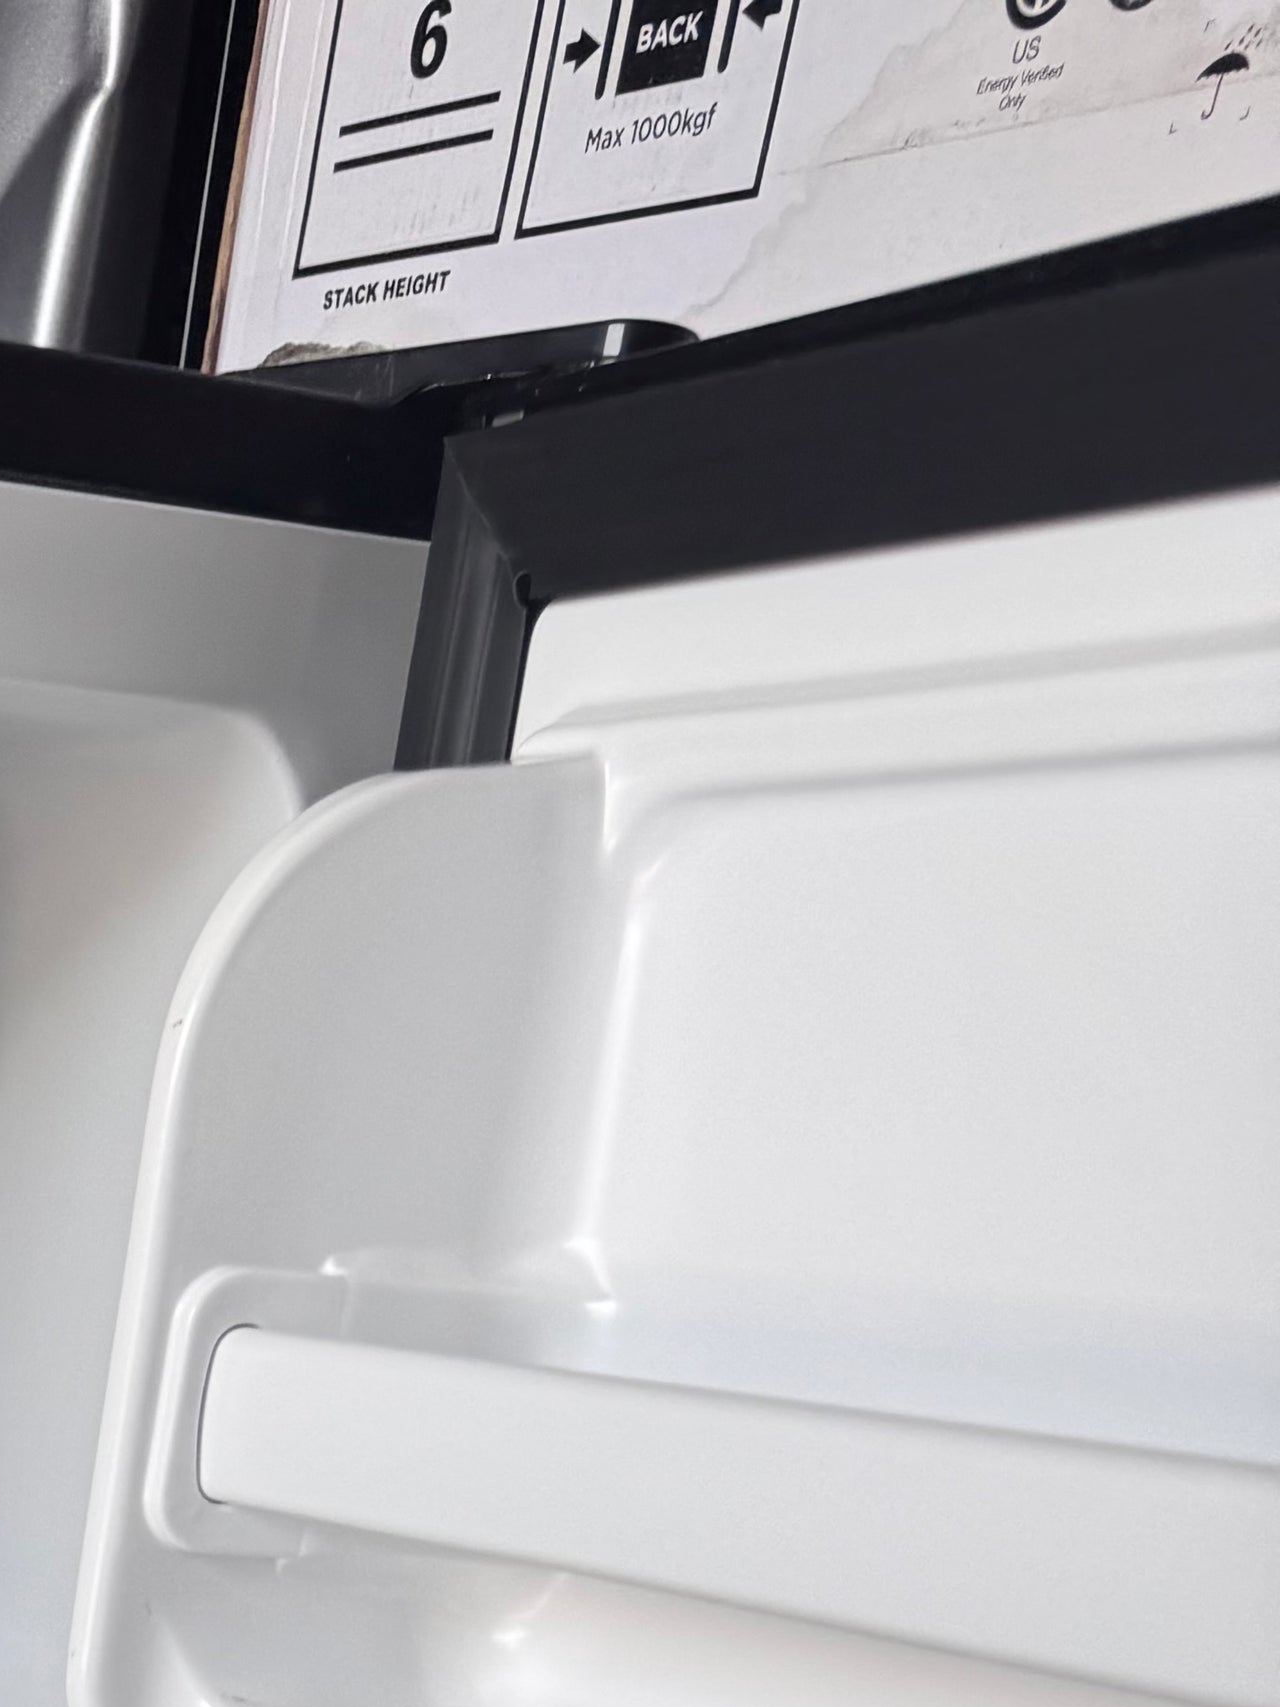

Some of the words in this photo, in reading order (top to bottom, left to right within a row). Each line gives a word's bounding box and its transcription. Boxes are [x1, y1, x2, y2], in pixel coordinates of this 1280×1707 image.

[410, 0, 452, 78] 6
[636, 11, 703, 53] BACK
[1012, 35, 1042, 64] US
[976, 75, 1018, 95] Energy
[998, 94, 1027, 111] Only
[585, 125, 623, 153] Max
[631, 102, 718, 143] 1000kgf
[323, 282, 378, 310] STACK
[382, 270, 451, 301] HEIGHT
